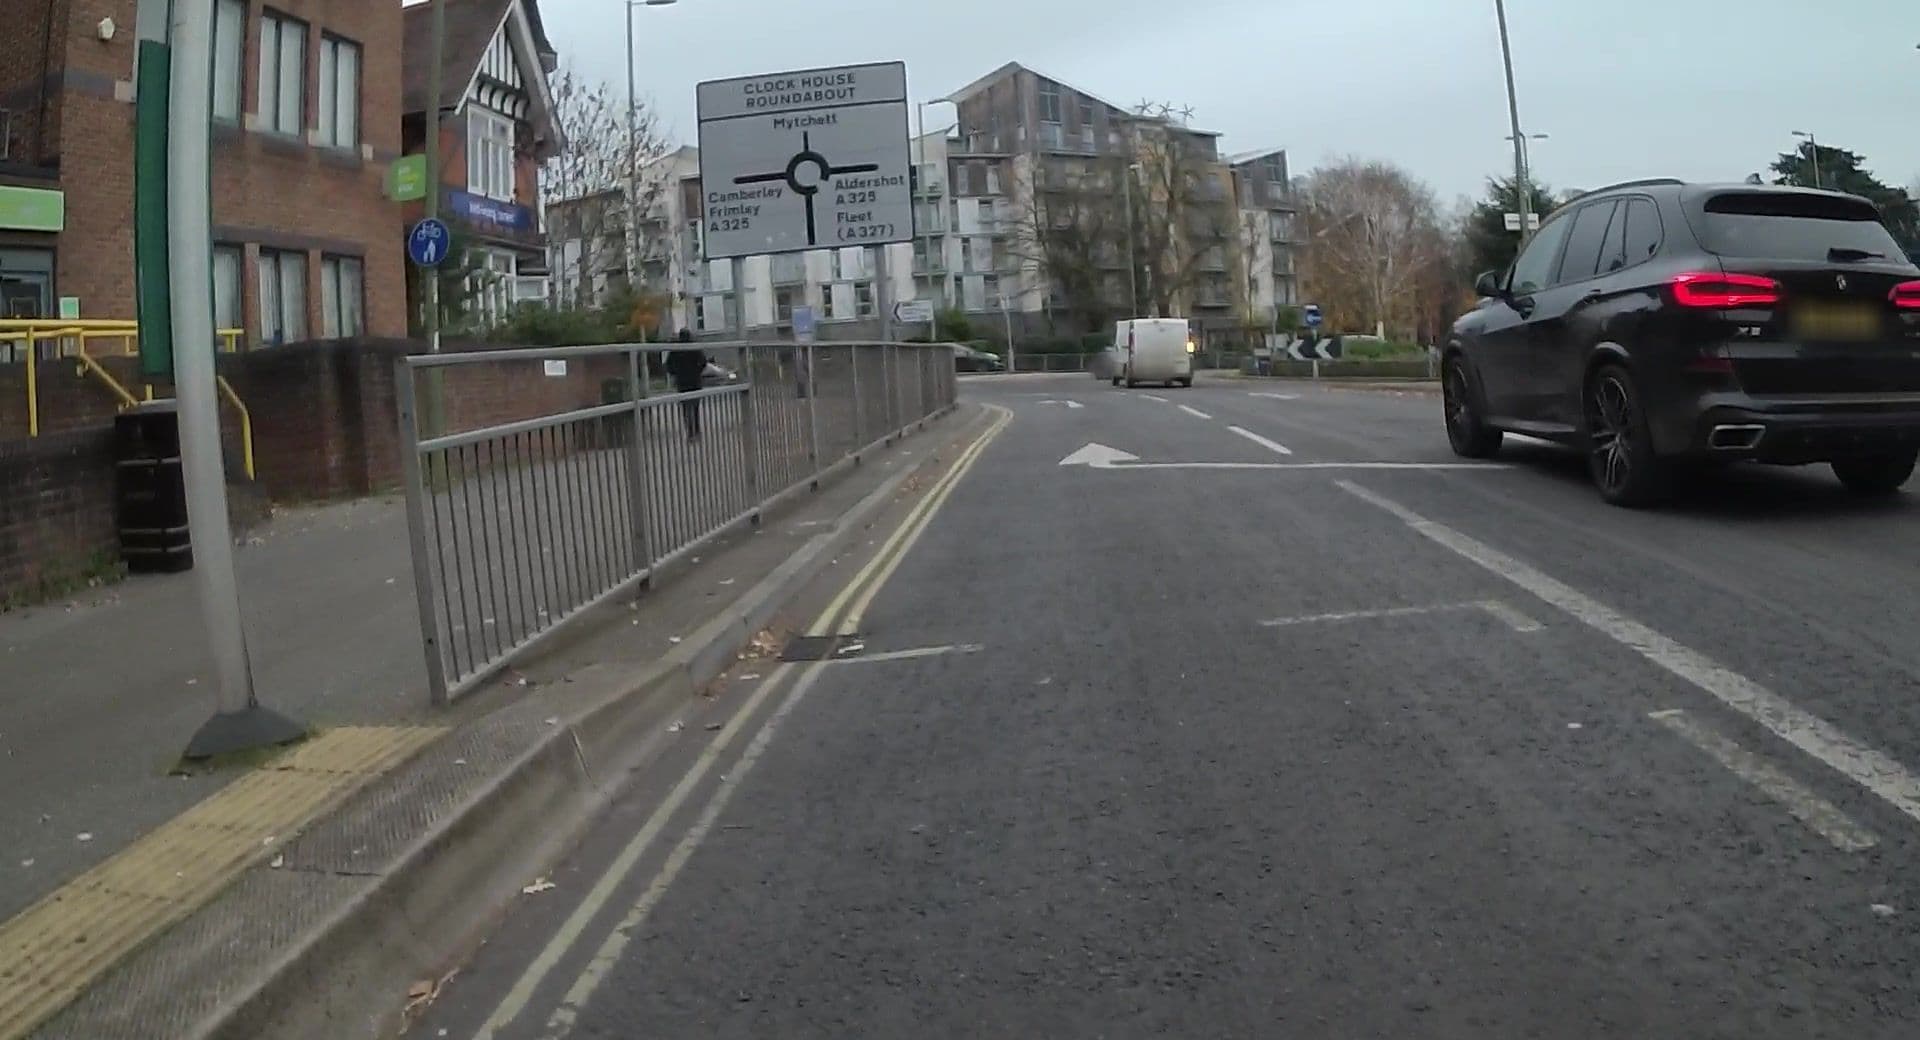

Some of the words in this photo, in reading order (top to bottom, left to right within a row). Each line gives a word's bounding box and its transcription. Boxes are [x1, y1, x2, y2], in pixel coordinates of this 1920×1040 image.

[744, 79, 796, 95] CLOCK
[801, 73, 856, 91] HOUSE
[746, 86, 856, 108] ROUNDABOUT
[773, 112, 838, 130] Mytchett
[835, 174, 905, 191] Aldershot
[708, 185, 783, 204] Camberley
[835, 190, 876, 206] A325
[709, 203, 761, 219] Frimley
[837, 210, 873, 223] Fleet
[709, 217, 750, 232] A325
[837, 223, 895, 241] (A327)
